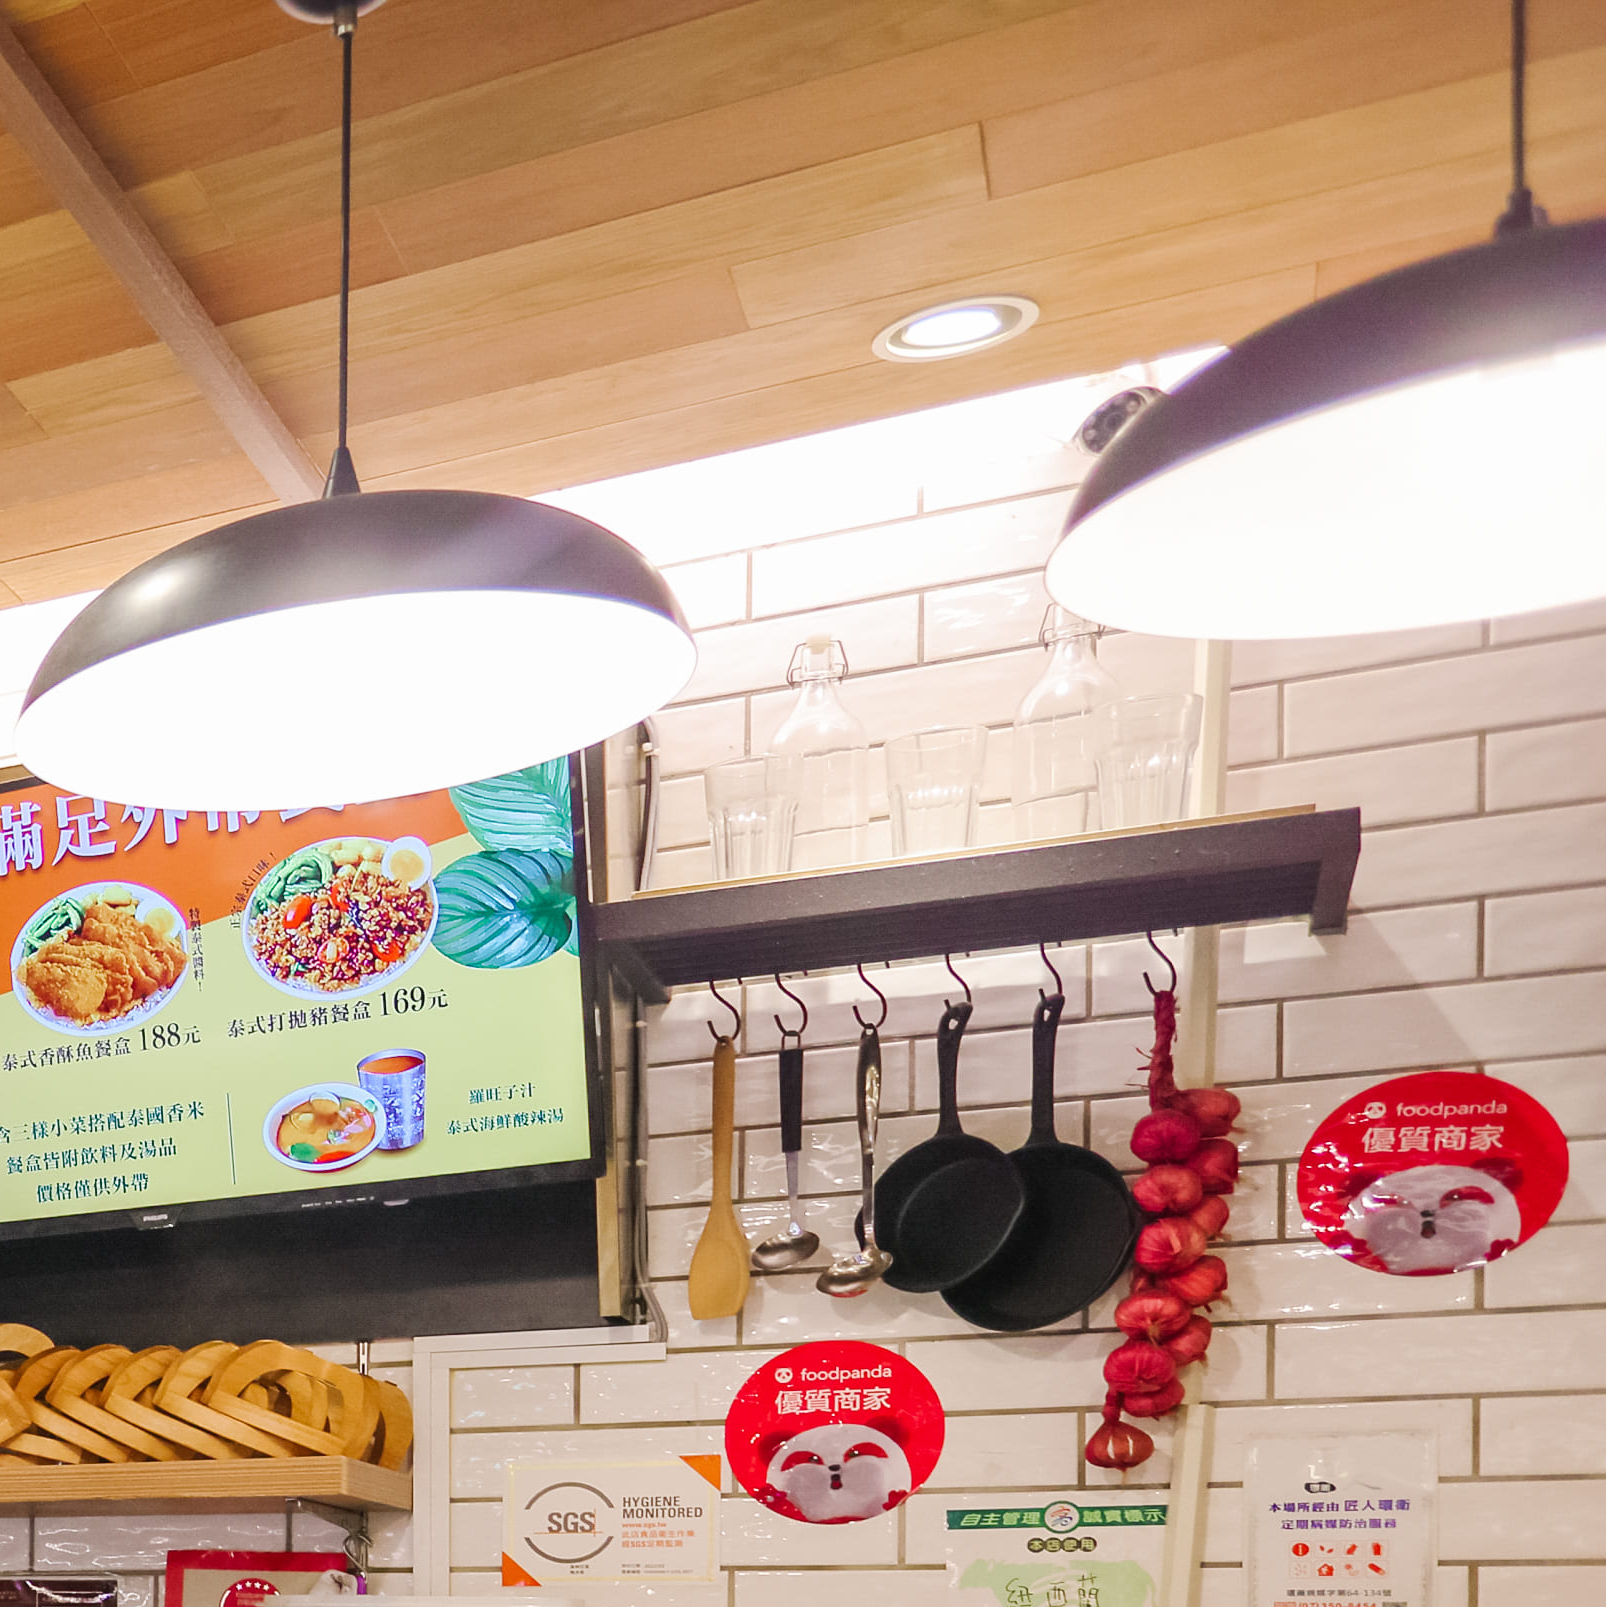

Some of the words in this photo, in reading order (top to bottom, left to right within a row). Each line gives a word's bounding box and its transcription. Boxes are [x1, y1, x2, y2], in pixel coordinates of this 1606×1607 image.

[226, 999, 372, 1039] 泰式打拋豬餐盒
[379, 985, 449, 1018] 169元
[1, 1036, 132, 1072] 泰式香酥魚餐盒
[138, 1022, 202, 1052] 188元
[469, 1081, 536, 1105] 羅旺子汁
[1395, 1099, 1508, 1119] foodpanda
[446, 1107, 564, 1136] 泰式海鮮酸辣湯
[1361, 1124, 1505, 1154] 優質商家
[6, 1137, 177, 1175] 餐盒皆附飲料及湯品
[36, 1173, 149, 1204] 價格僅供外帶
[800, 1363, 892, 1384] foodpanda
[774, 1385, 891, 1416] 優質商家
[622, 1496, 681, 1508] HYGIENE
[622, 1507, 704, 1520] MONITORED
[547, 1511, 595, 1534] SGS
[959, 1511, 1042, 1527] 自主管理
[1028, 1537, 1096, 1552] 本店使用
